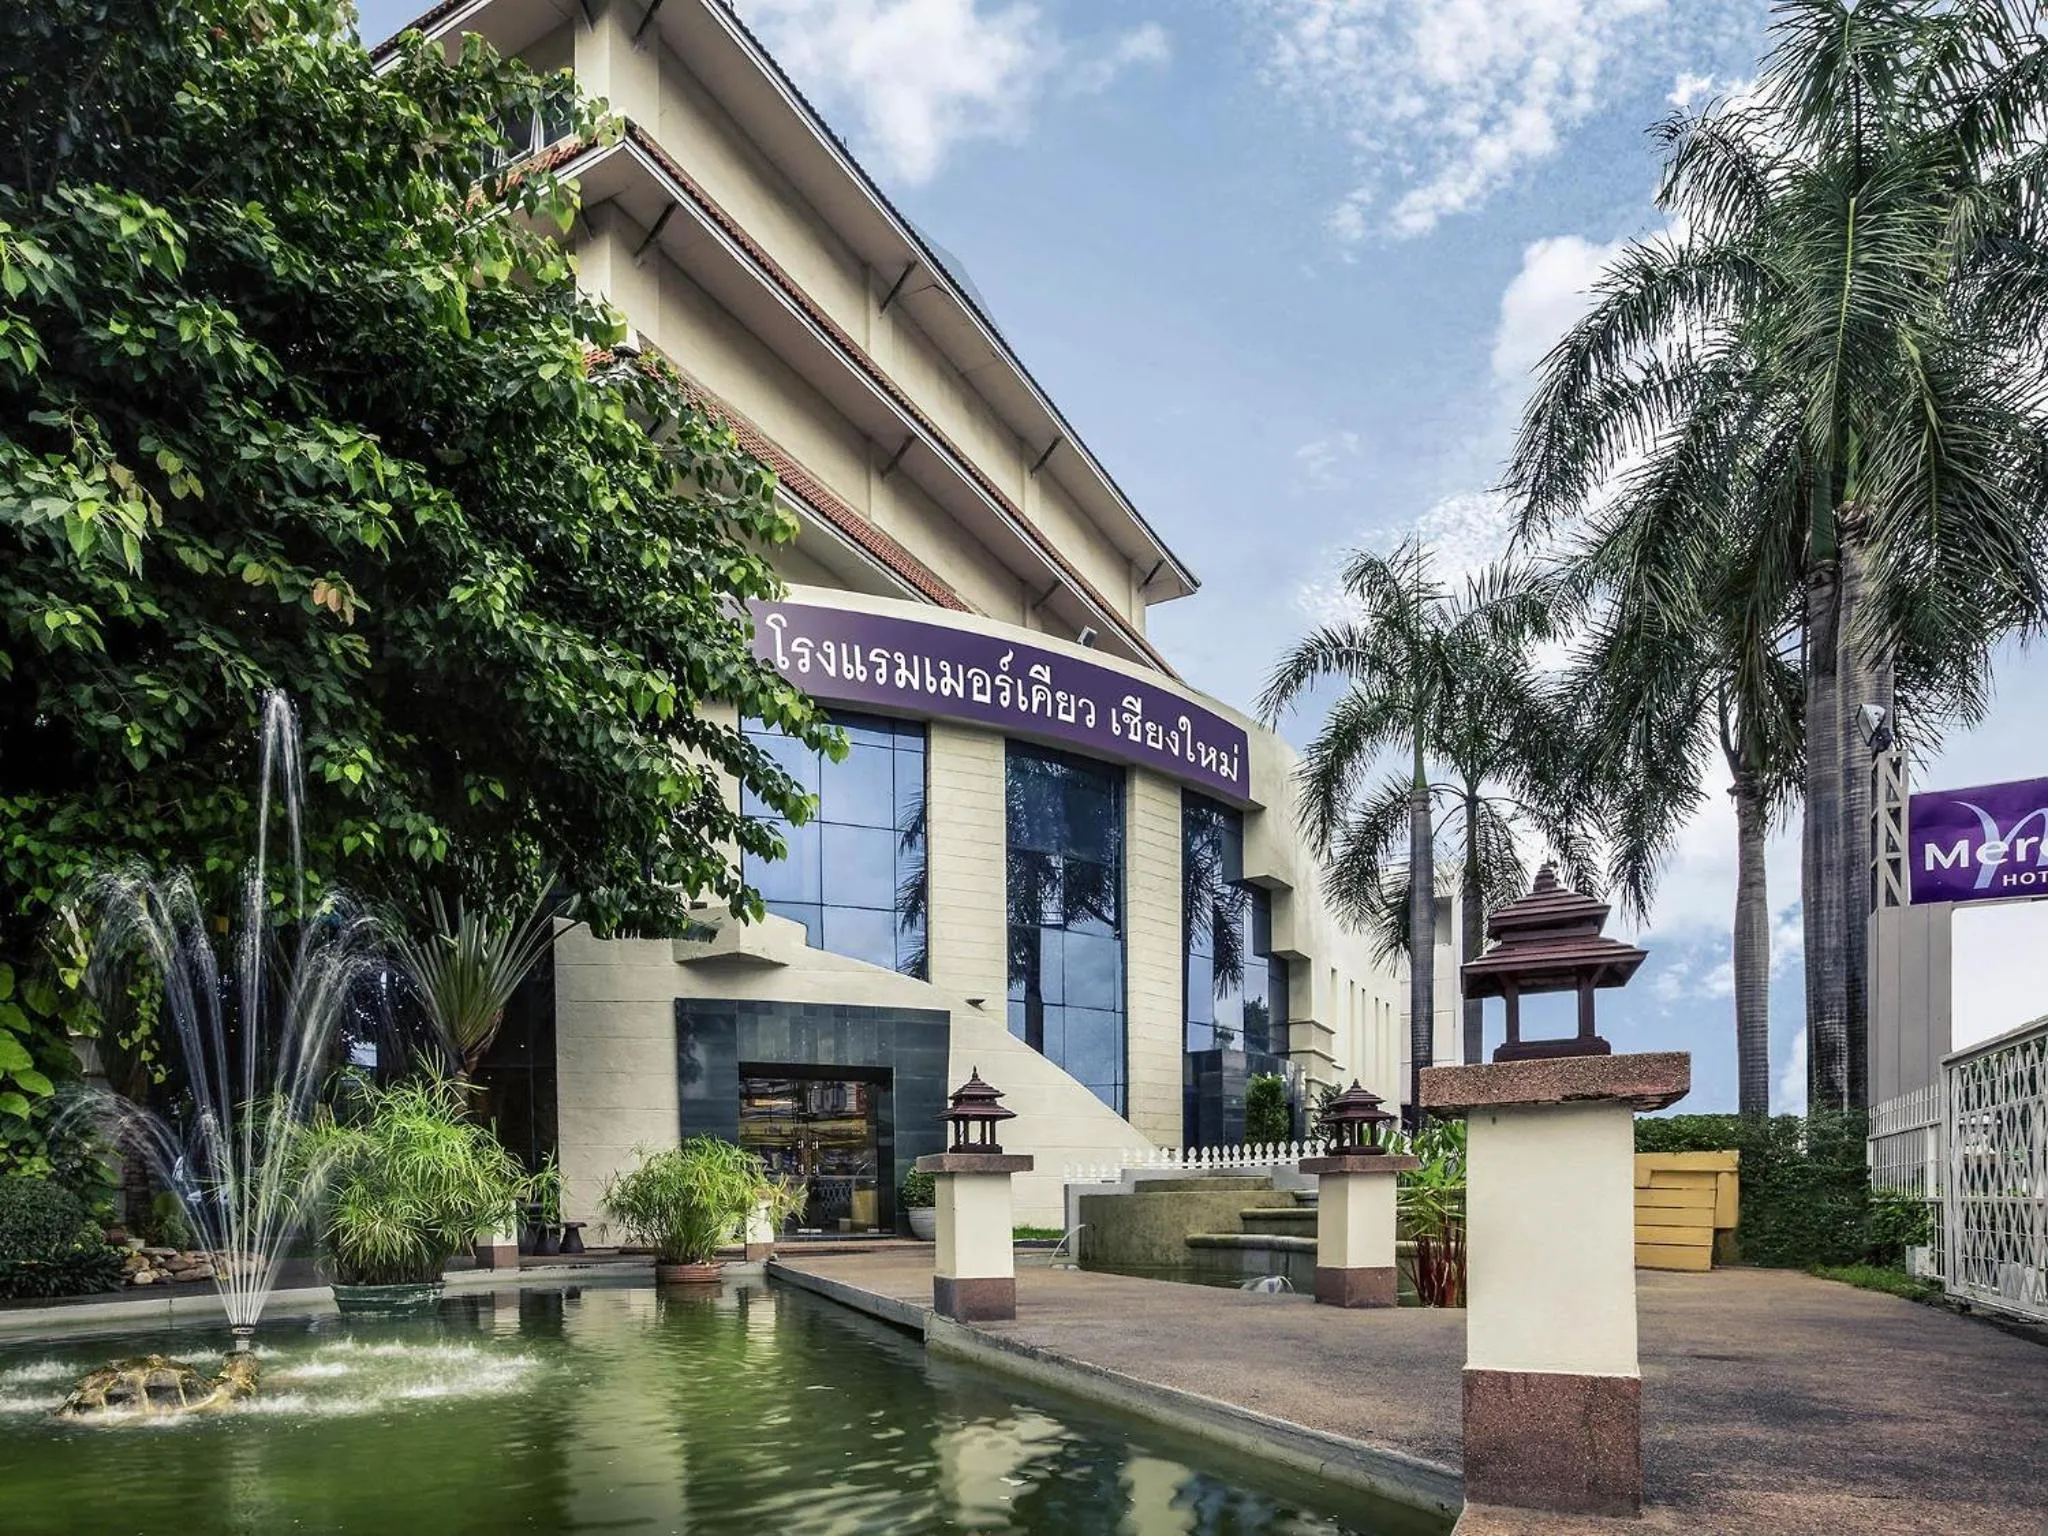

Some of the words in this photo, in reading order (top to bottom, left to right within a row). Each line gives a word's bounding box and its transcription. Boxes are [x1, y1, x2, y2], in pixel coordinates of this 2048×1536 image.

[765, 612, 1096, 729] โรงแรมเมอร์เคียว
[1111, 694, 1238, 783] เชียงใหม่
